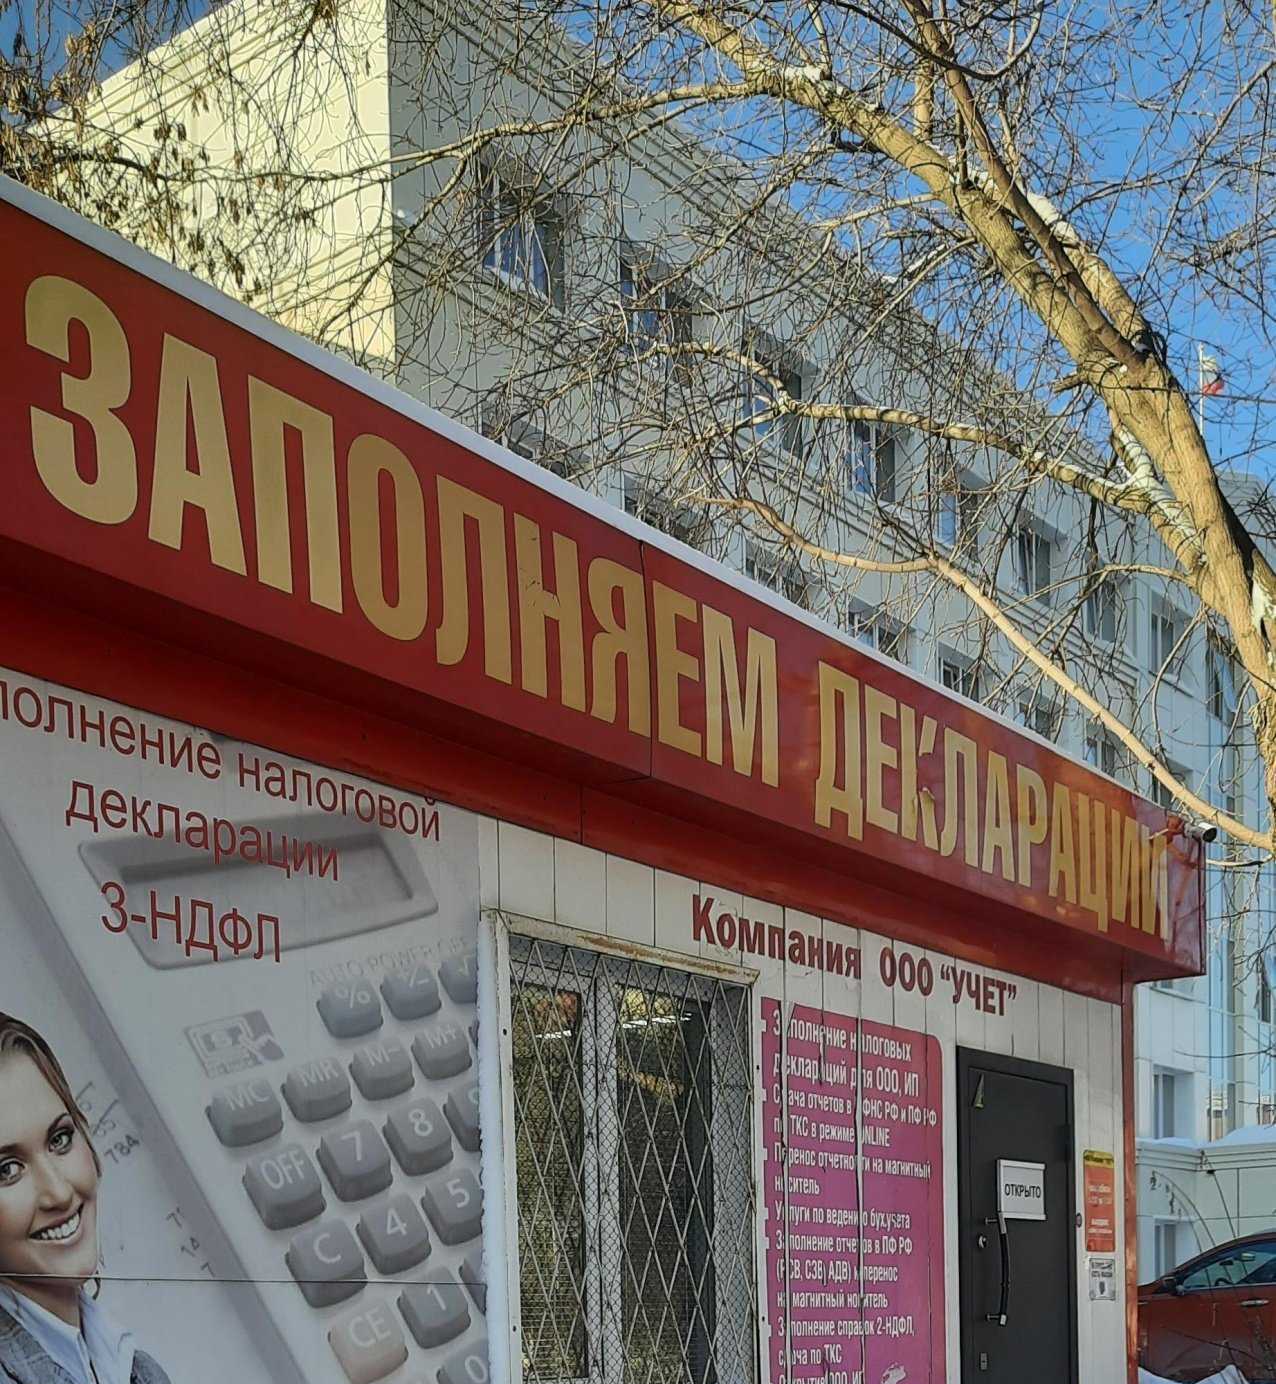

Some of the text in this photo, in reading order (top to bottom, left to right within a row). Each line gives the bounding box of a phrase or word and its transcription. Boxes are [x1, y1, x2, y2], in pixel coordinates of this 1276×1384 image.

[24, 274, 1171, 942] ЗАПОЛНЯЕМ ДЕКЛАРАЦИИ
[238, 752, 441, 842] налоговой
[65, 780, 340, 881] декларации
[100, 880, 281, 963] 3-НДФЛ
[692, 894, 862, 980] Компания
[879, 946, 934, 997] ООО
[772, 1009, 847, 1049] Зполнение
[904, 1071, 919, 1098] ИП
[773, 1083, 806, 1107] Сача
[807, 1093, 845, 1113] отчетов
[846, 1100, 852, 1115] в
[885, 1101, 899, 1122] РФ
[908, 1105, 923, 1125] ПФ
[407, 1108, 434, 1137] 8
[790, 1114, 809, 1138] ТКС
[811, 1122, 817, 1137] в
[819, 1123, 855, 1144] режиме
[340, 1130, 364, 1162] 7
[259, 1149, 305, 1190] OFF
[872, 1158, 884, 1173] на
[447, 1178, 471, 1209] 5
[1003, 1182, 1042, 1200] ОТКРЫТО
[385, 1207, 408, 1237] 4
[812, 1207, 824, 1225] по
[312, 1232, 343, 1265] C
[882, 1235, 897, 1253] ПФ
[898, 1236, 913, 1256] РФ
[426, 1282, 448, 1312] 1
[792, 1288, 844, 1309] магнитный
[350, 1310, 392, 1348] CE
[777, 1316, 835, 1338] Зполнение
[810, 1348, 822, 1364] по
[823, 1343, 842, 1364] ТКС
